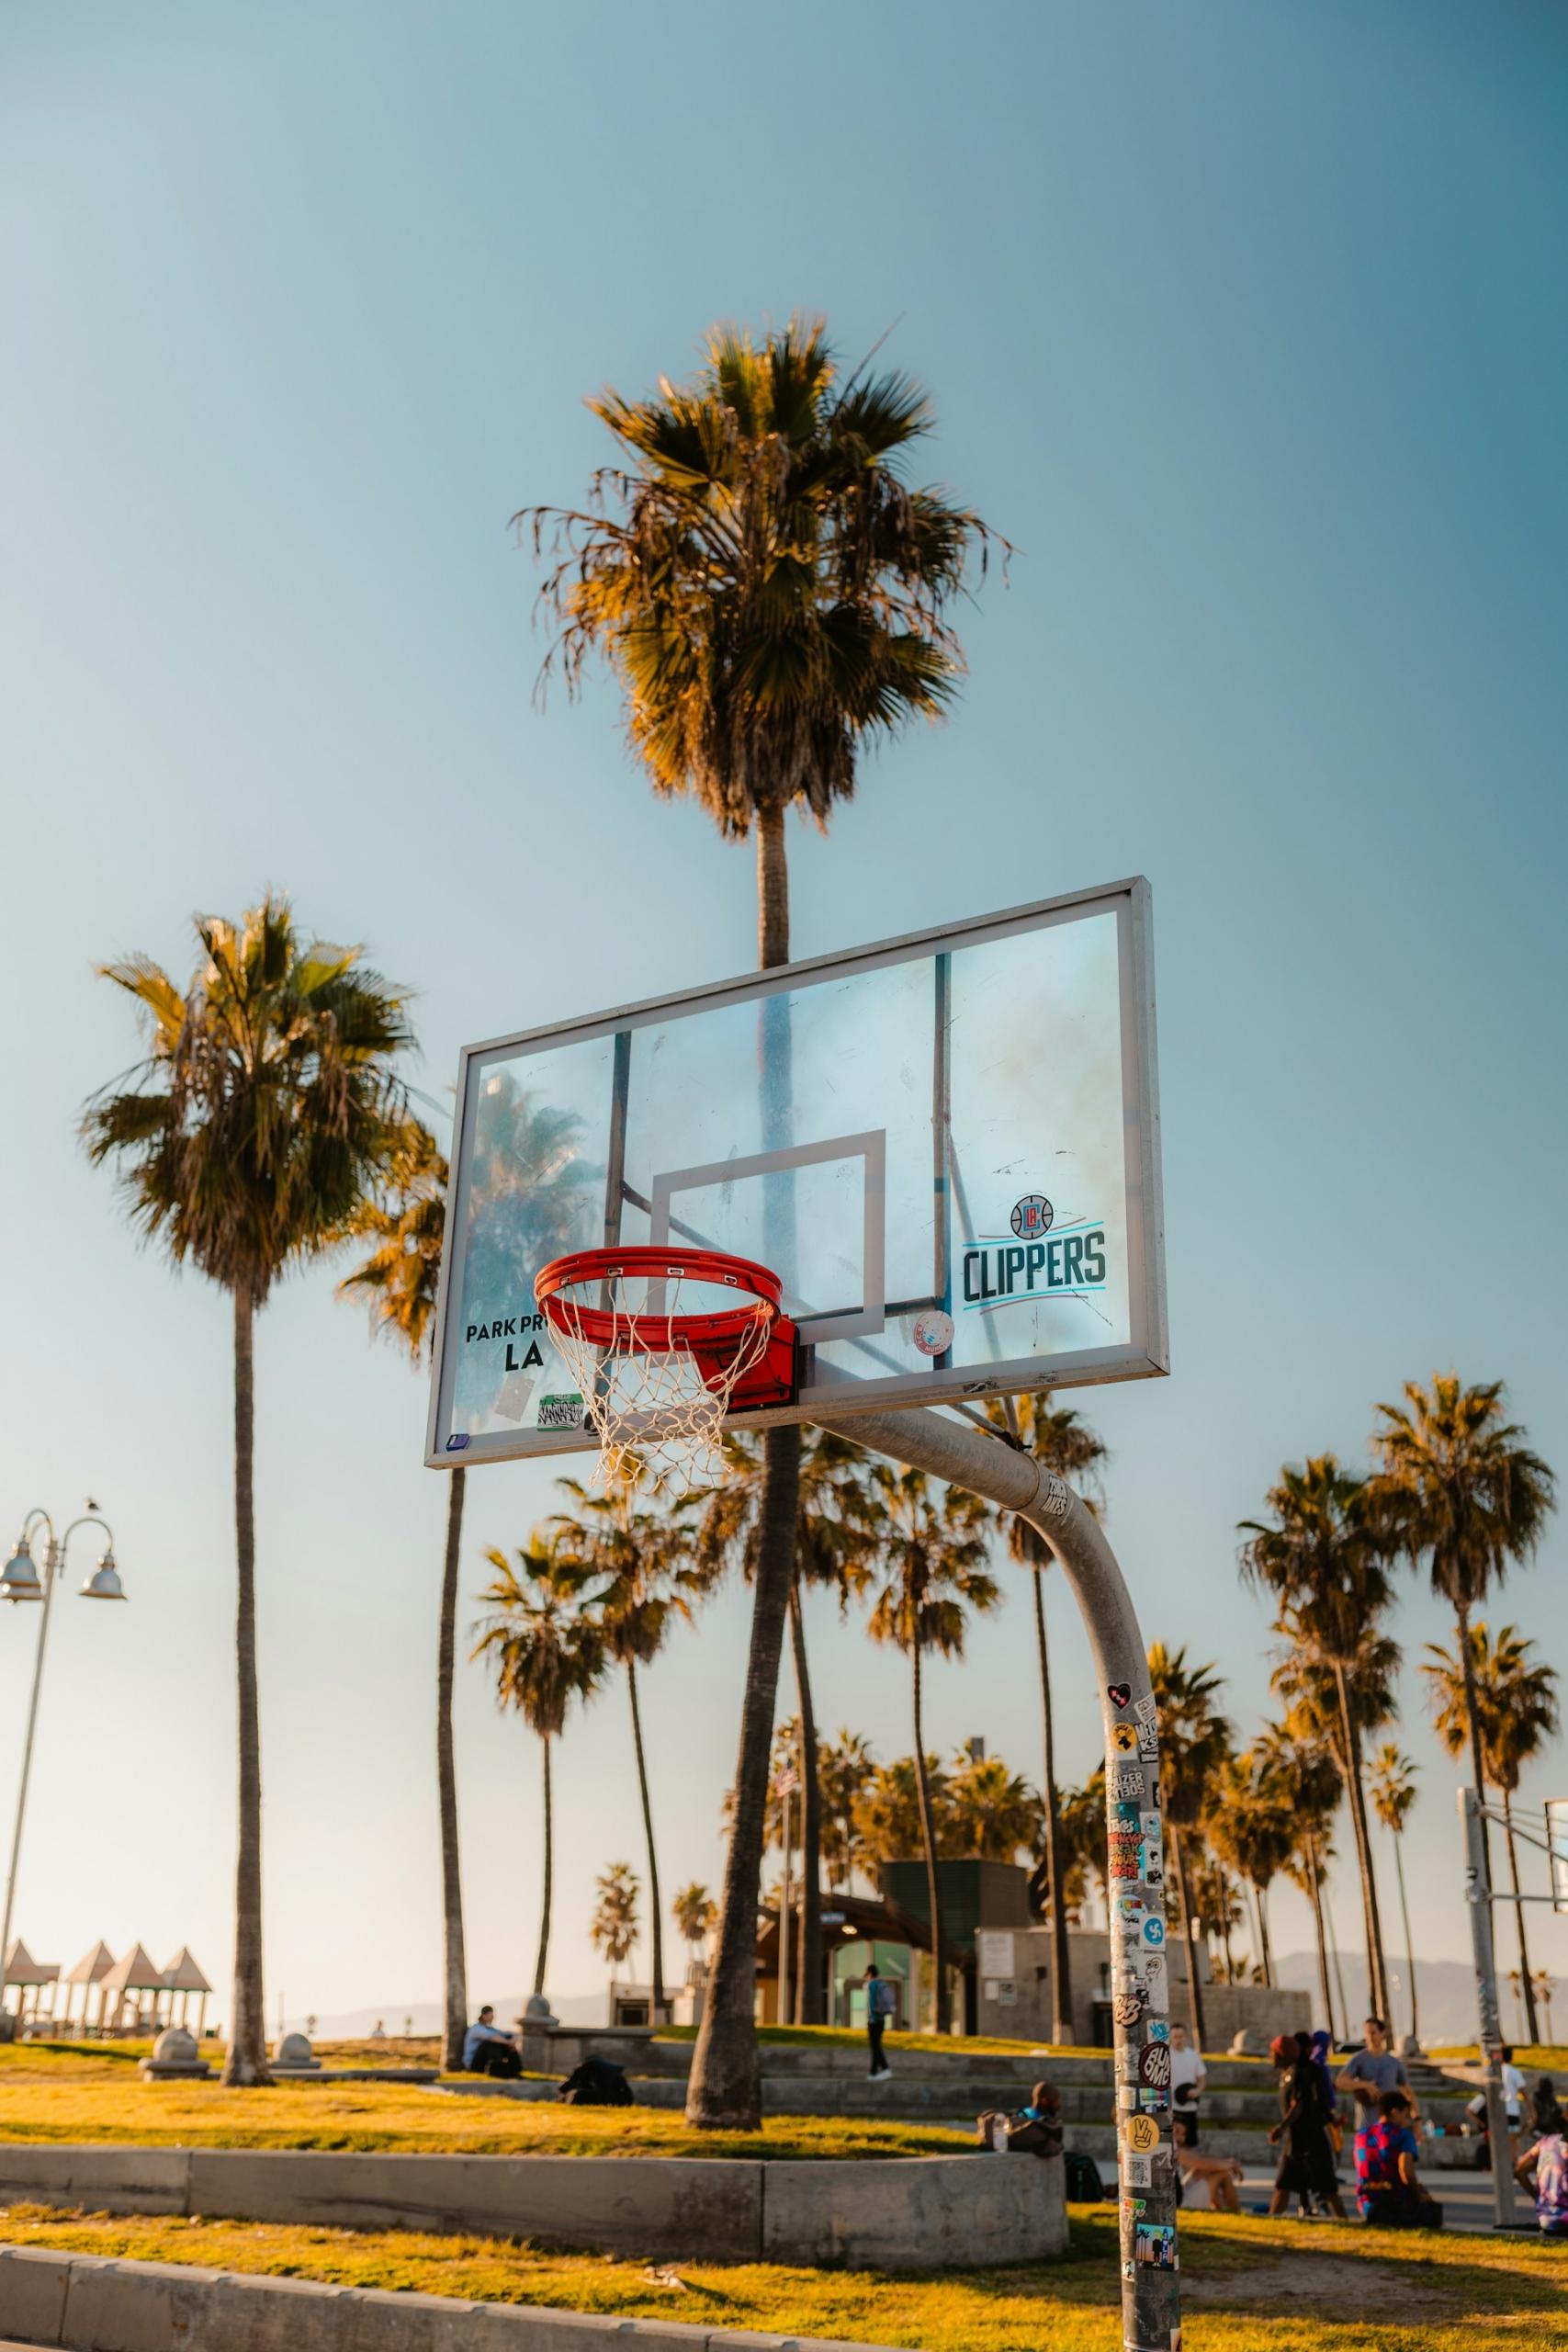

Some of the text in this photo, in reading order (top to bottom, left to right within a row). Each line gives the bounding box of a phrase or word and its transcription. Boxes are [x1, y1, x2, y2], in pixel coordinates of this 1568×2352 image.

[964, 1231, 1106, 1302] CLIPPERS
[466, 1314, 548, 1342] PARK PR
[505, 1340, 545, 1372] LA
